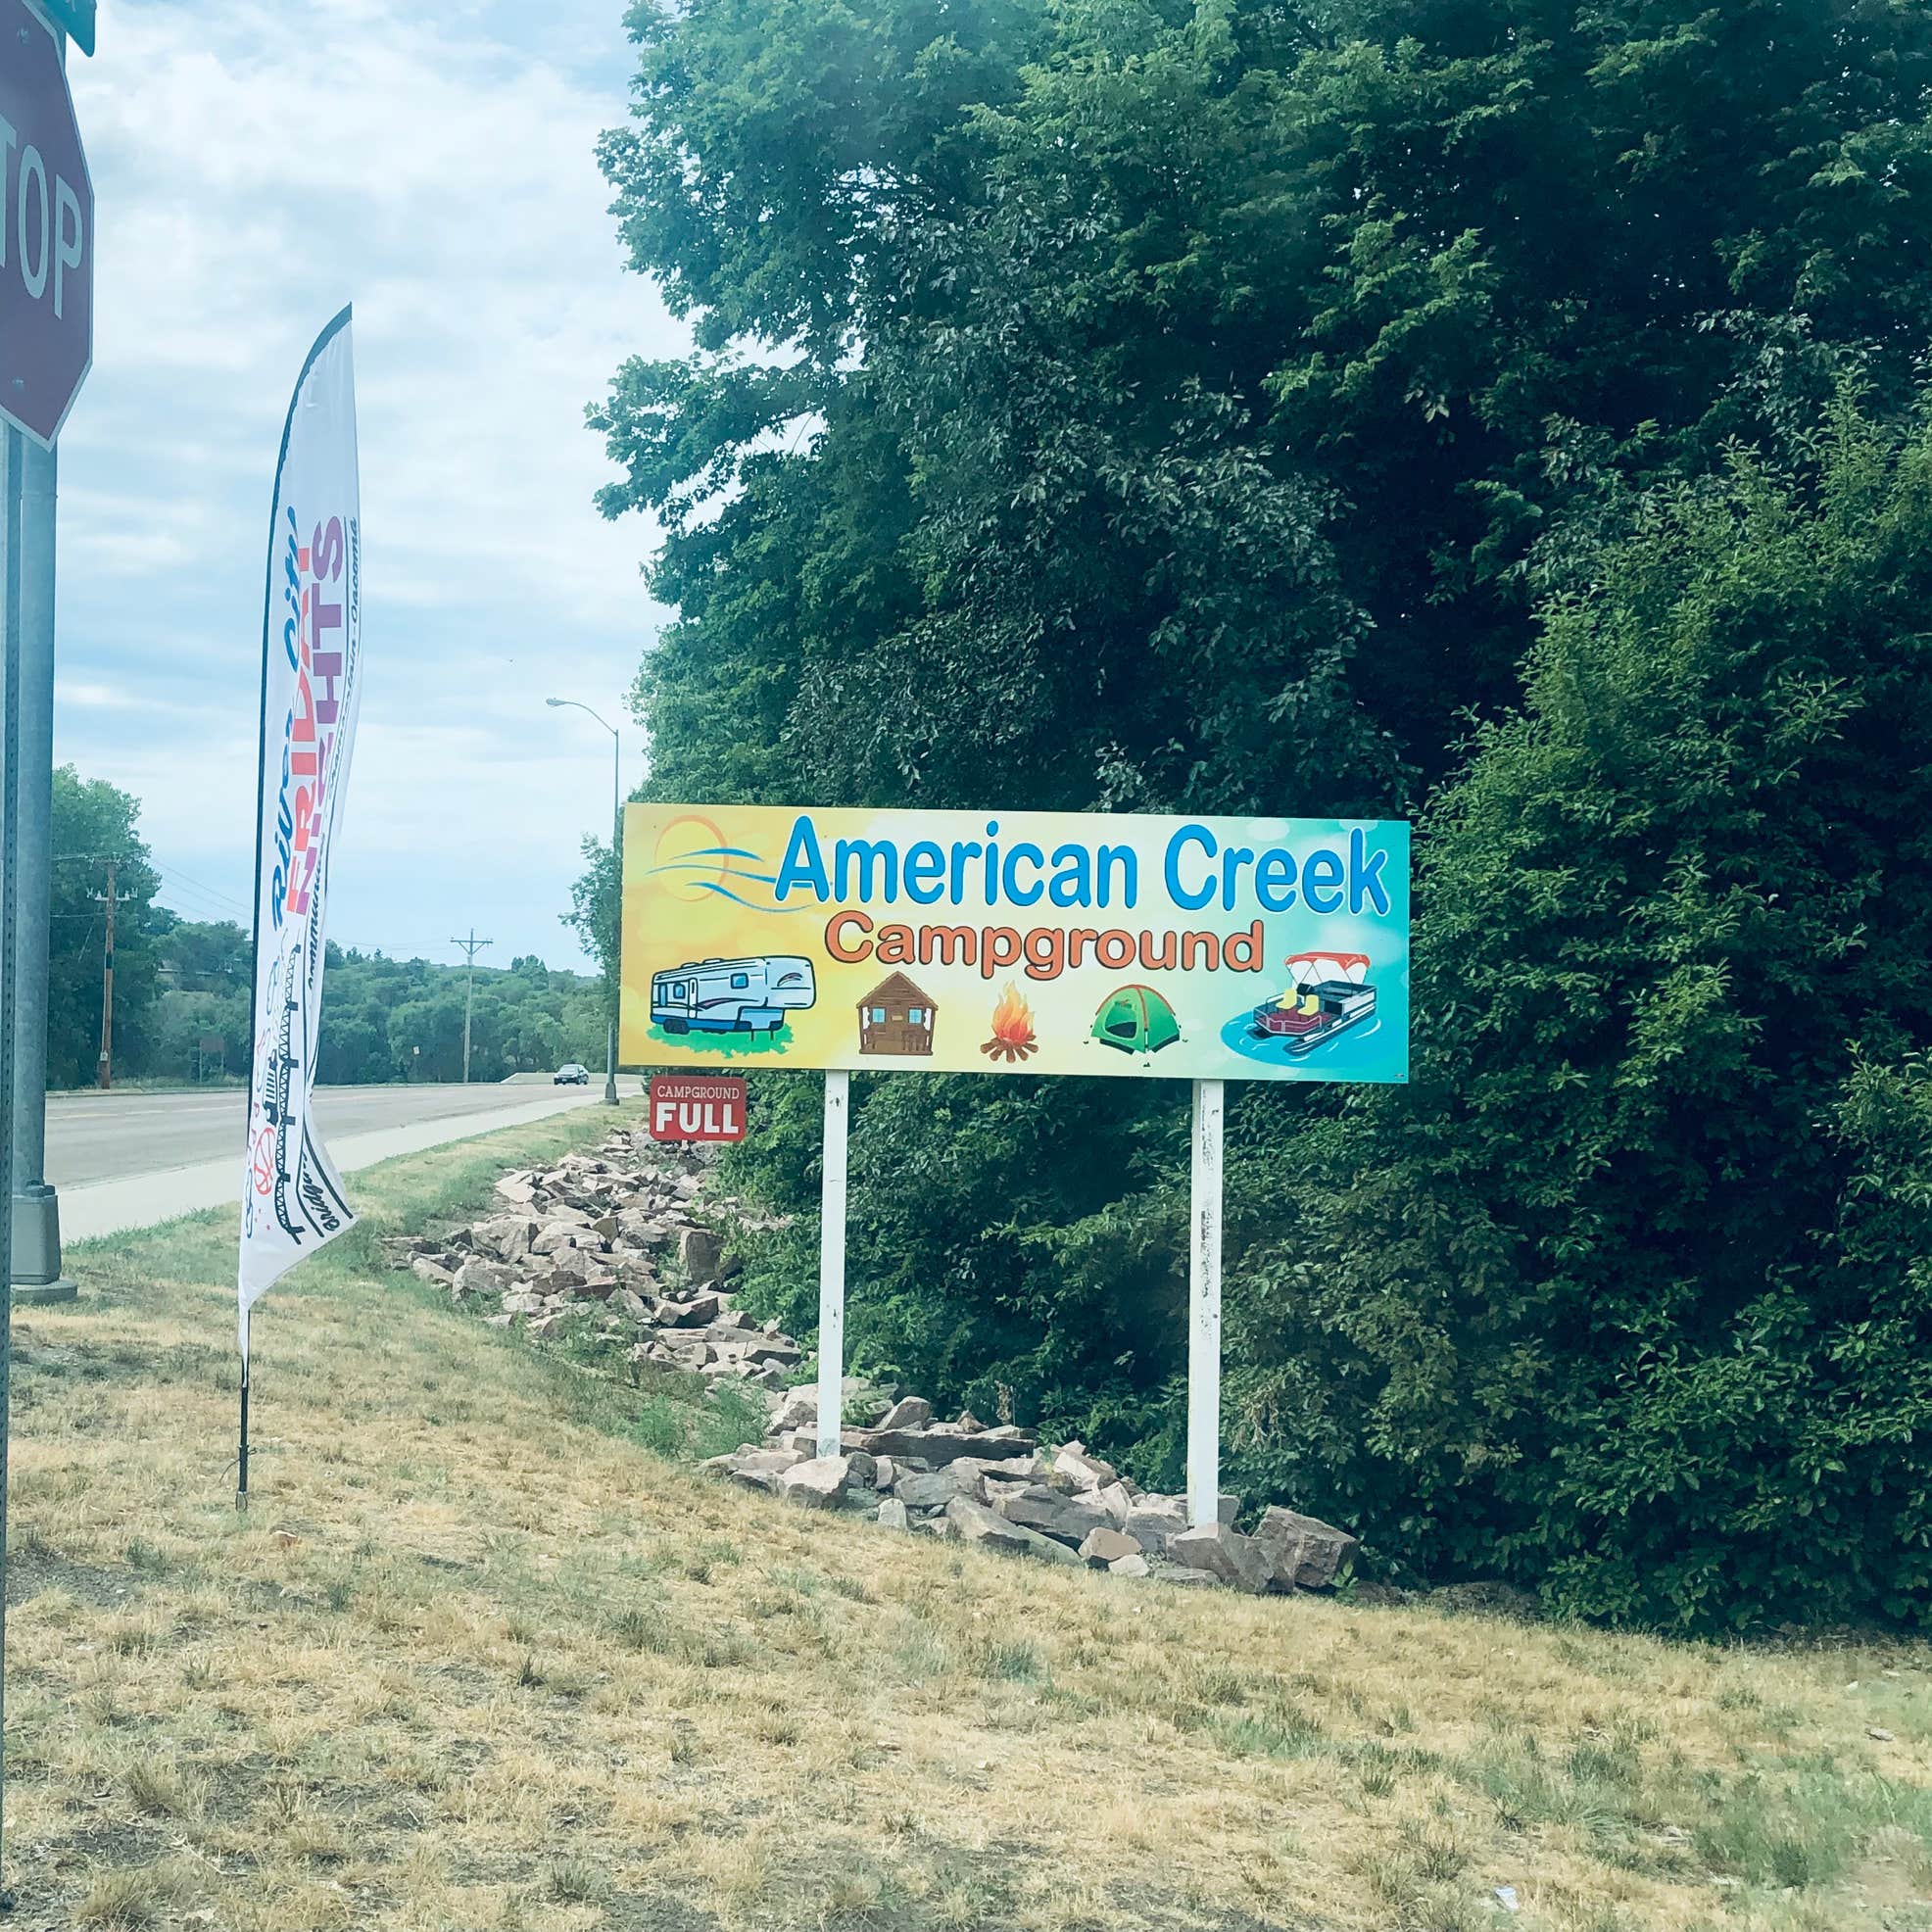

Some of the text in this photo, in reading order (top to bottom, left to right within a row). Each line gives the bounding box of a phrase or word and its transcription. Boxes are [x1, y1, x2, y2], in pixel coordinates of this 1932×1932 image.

[0, 114, 82, 320] TOP
[272, 506, 301, 931] River City
[775, 815, 1389, 915] American Creek
[825, 910, 1264, 981] Campground
[655, 1102, 739, 1134] FULL
[657, 1085, 740, 1099] CAMPGROUND
